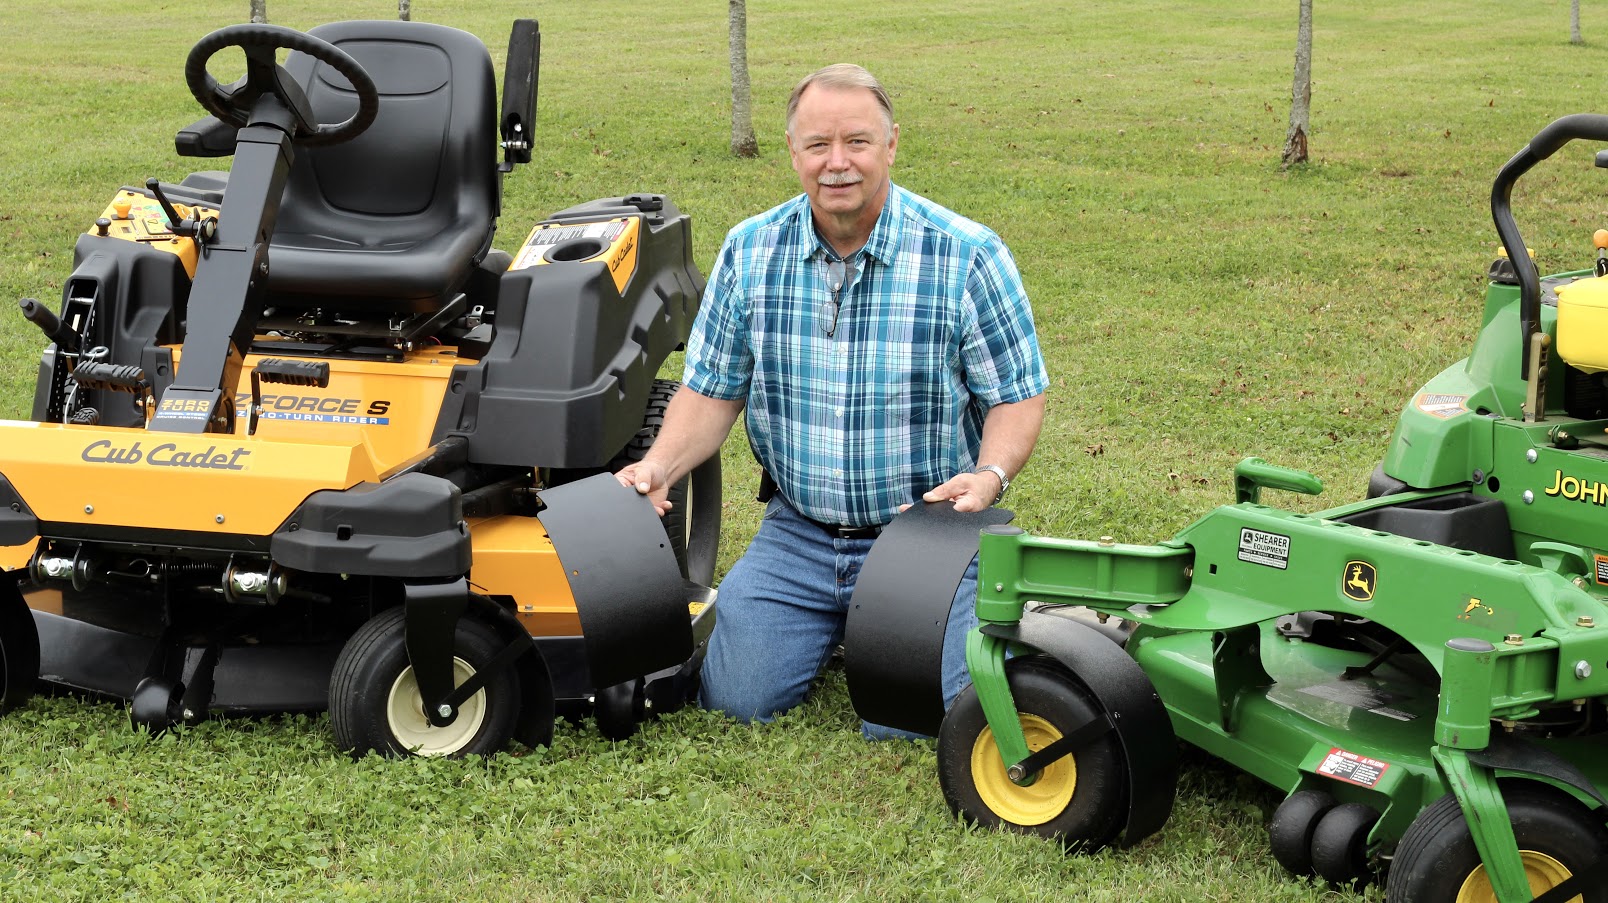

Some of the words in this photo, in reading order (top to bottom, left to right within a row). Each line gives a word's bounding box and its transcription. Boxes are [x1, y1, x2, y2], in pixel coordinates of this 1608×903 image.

[163, 399, 210, 407] ZERO
[366, 400, 391, 415] S
[332, 414, 378, 425] RIDER
[81, 439, 143, 464] Cub
[146, 443, 252, 470] Cadet
[1254, 533, 1288, 548] SHEARER
[1253, 543, 1287, 555] EQUIPMENT
